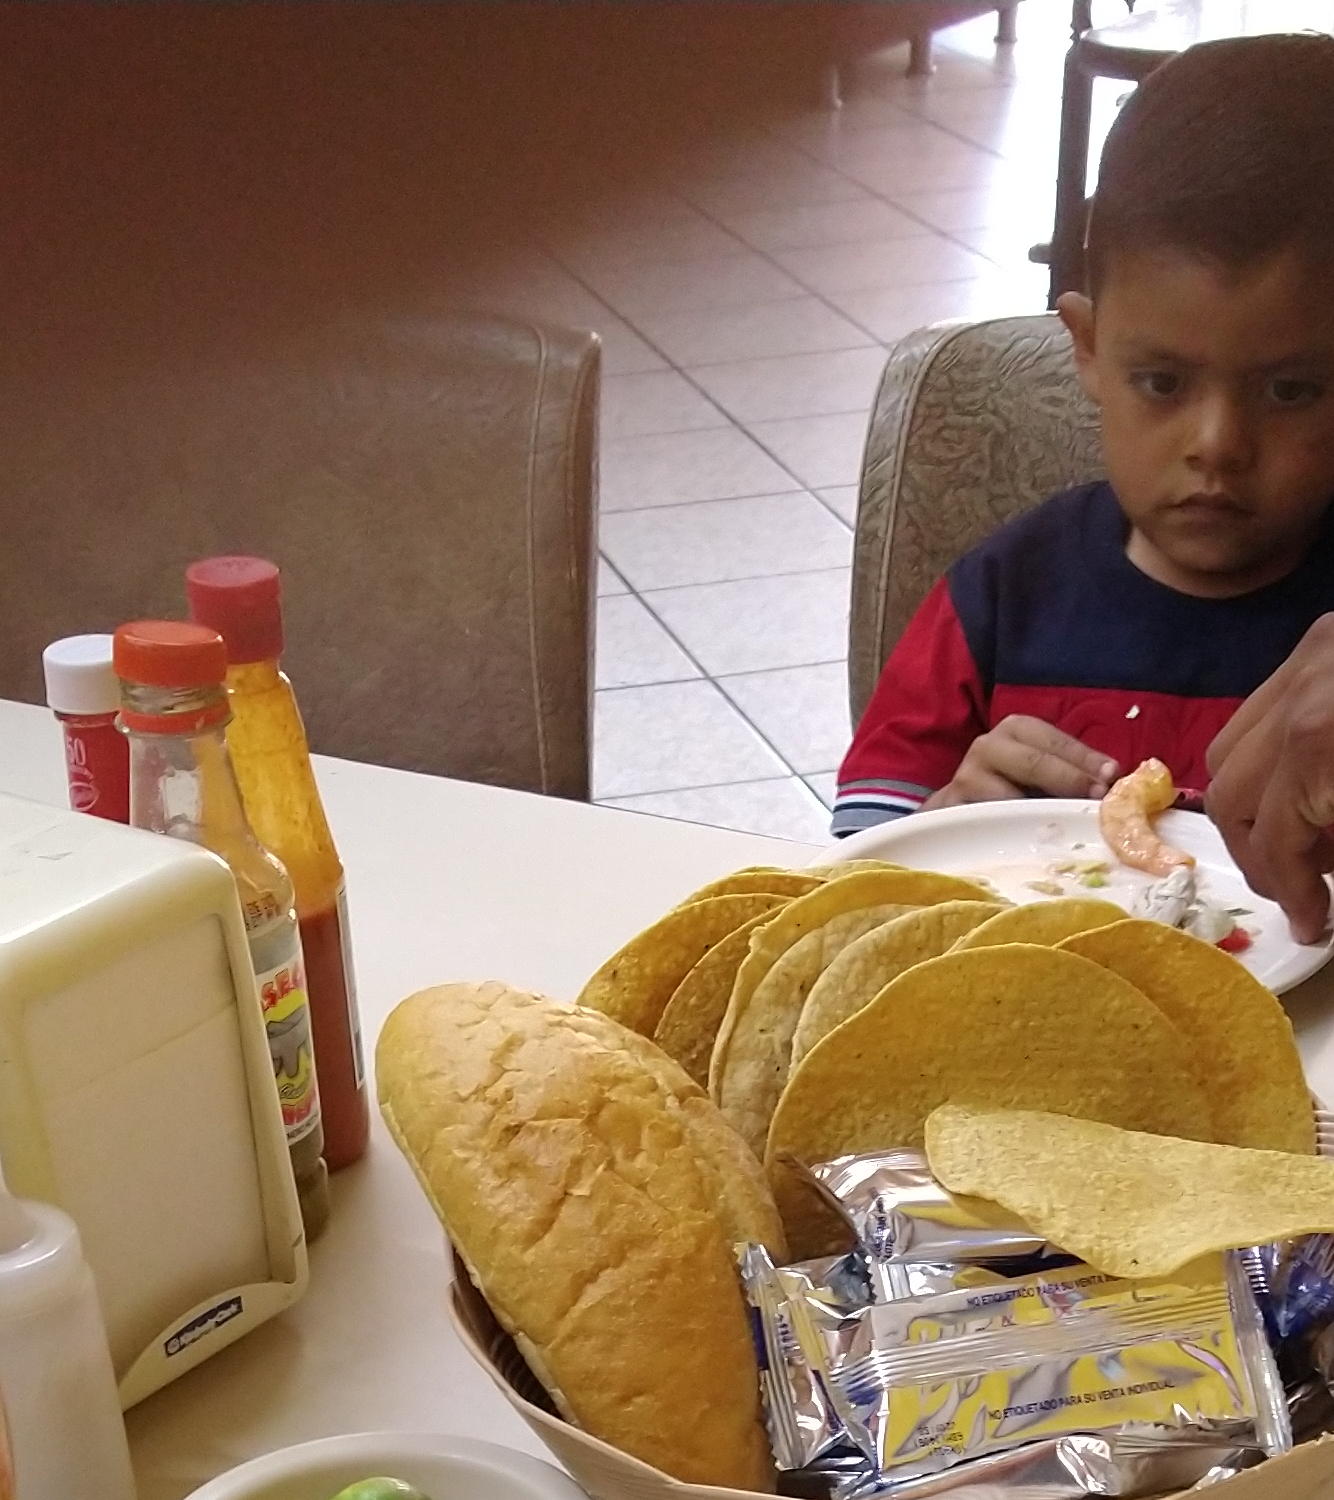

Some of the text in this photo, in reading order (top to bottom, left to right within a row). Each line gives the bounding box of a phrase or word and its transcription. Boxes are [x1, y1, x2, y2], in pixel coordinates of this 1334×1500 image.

[1003, 1399, 1058, 1419] ETIQUETADO
[1083, 1392, 1097, 1404] SU
[1097, 1388, 1126, 1402] VENTA
